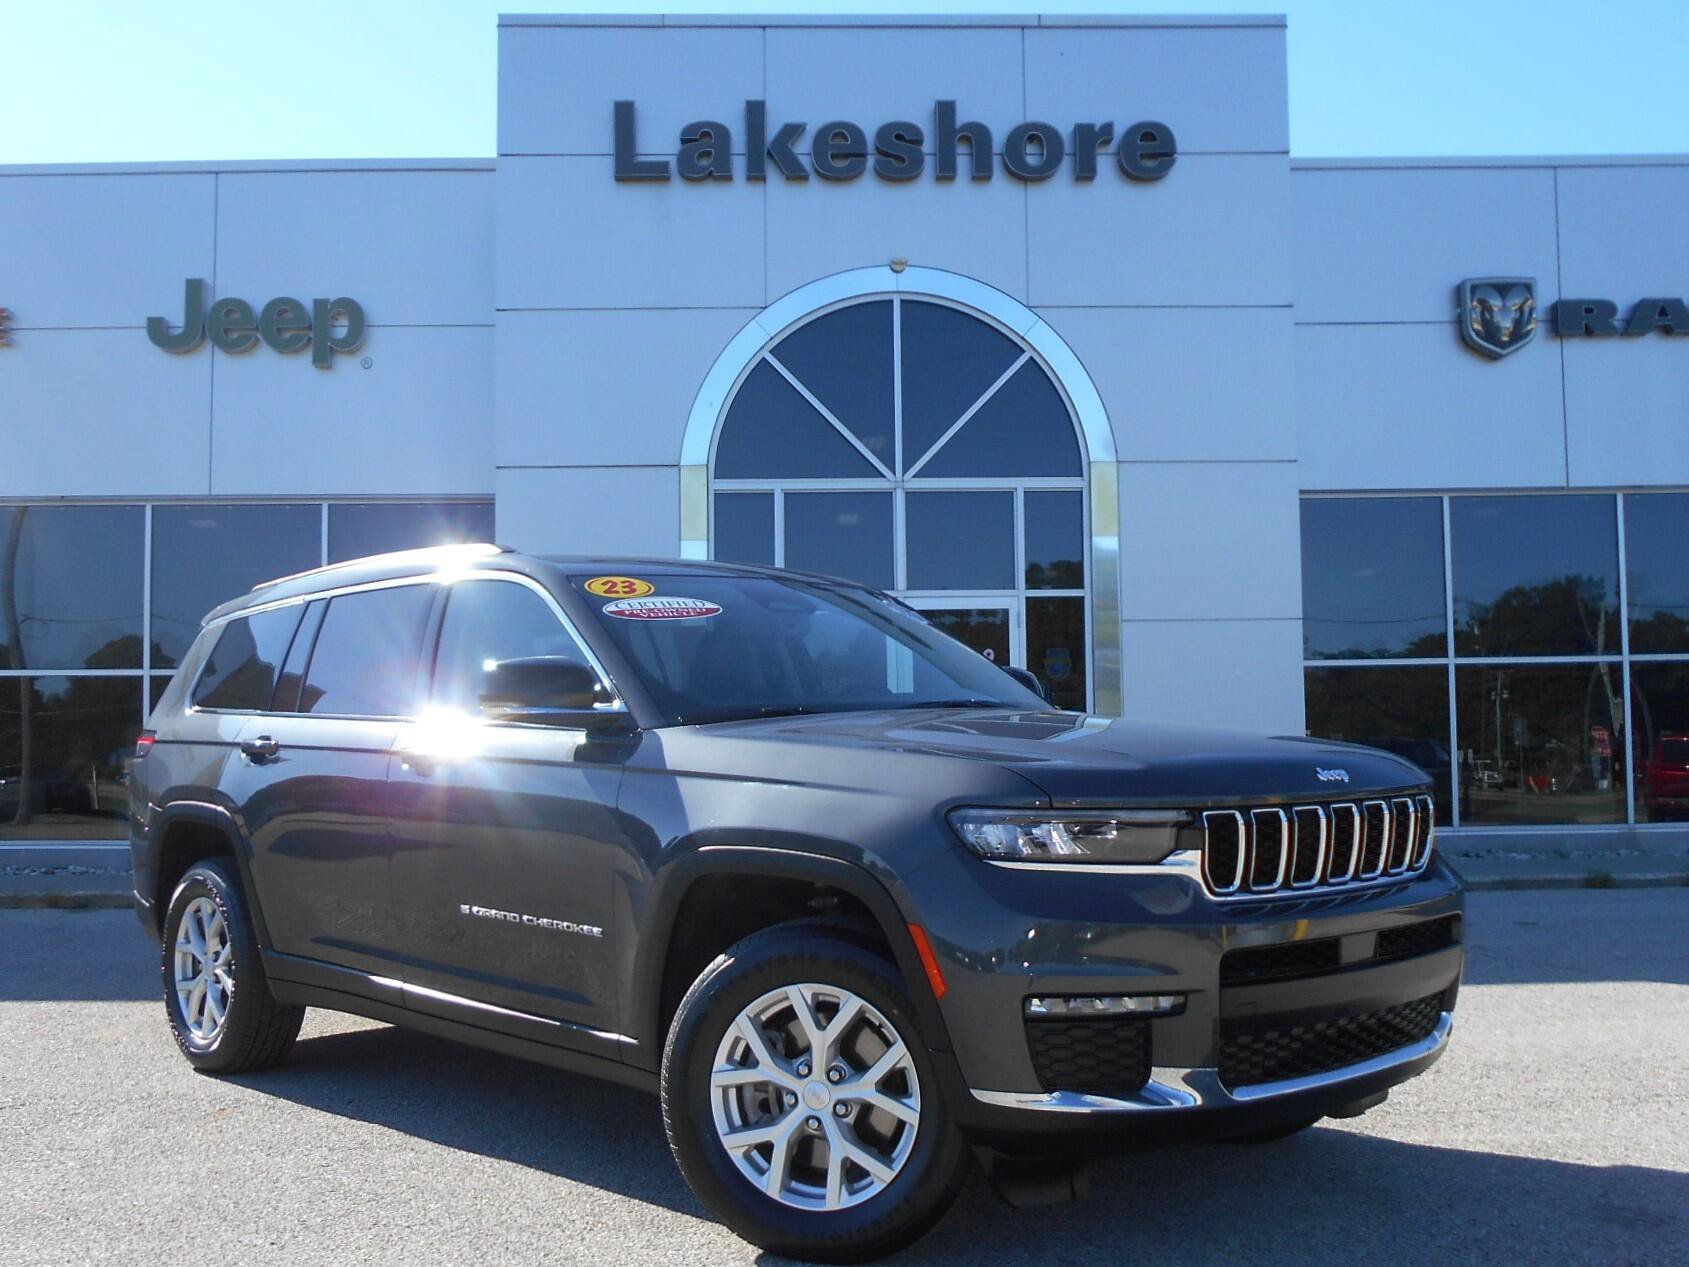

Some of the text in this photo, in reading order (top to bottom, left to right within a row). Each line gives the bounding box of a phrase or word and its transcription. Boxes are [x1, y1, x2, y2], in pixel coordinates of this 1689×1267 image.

[614, 100, 1178, 181] Lakeshore
[146, 278, 366, 369] Jeep
[601, 580, 638, 595] 23
[615, 600, 706, 609] CERTIFIED
[471, 906, 604, 938] GRAND CHEROKEE
